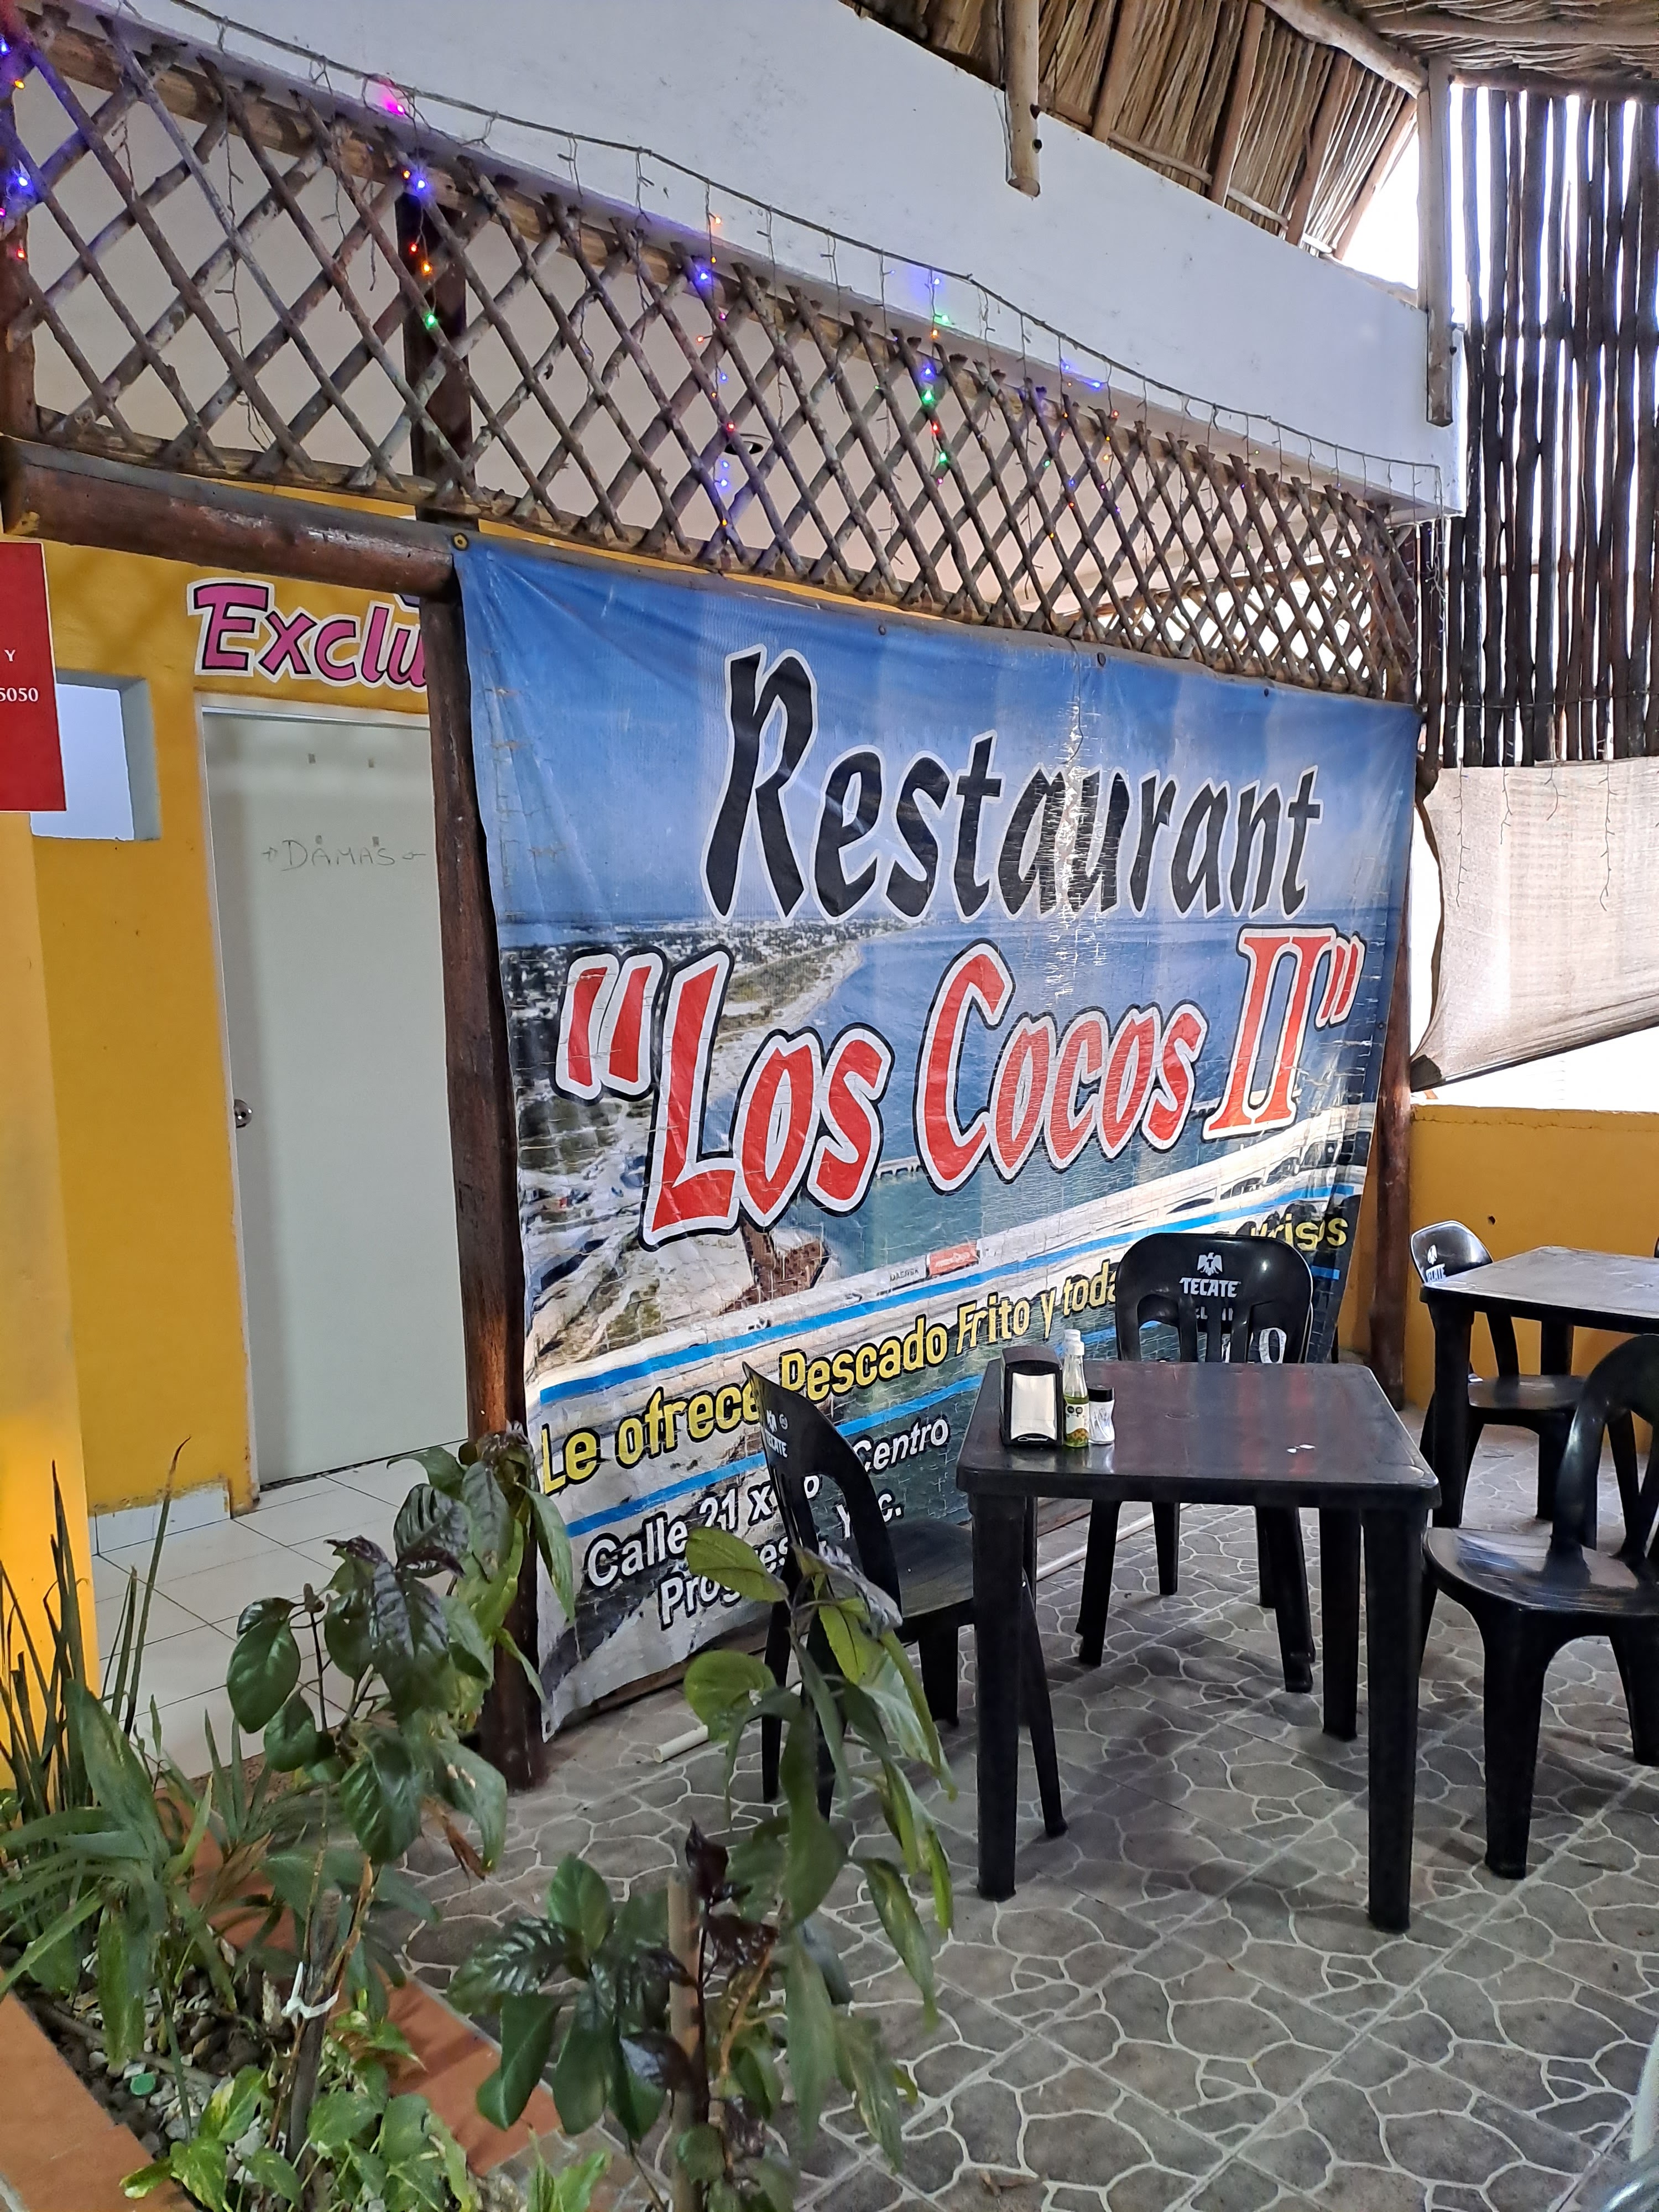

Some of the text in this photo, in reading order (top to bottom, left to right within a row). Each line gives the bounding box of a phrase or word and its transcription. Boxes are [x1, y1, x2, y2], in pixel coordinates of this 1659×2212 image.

[4, 649, 16, 662] Y
[701, 644, 1323, 925] Restaurant
[281, 837, 397, 872] DAMAS
[912, 937, 1210, 1196] Cocos
[1178, 1277, 1242, 1298] TECATE
[540, 1423, 600, 1496] Le
[956, 1291, 1031, 1354] Frito
[1040, 1288, 1057, 1340] y
[587, 1515, 689, 1587] Calle
